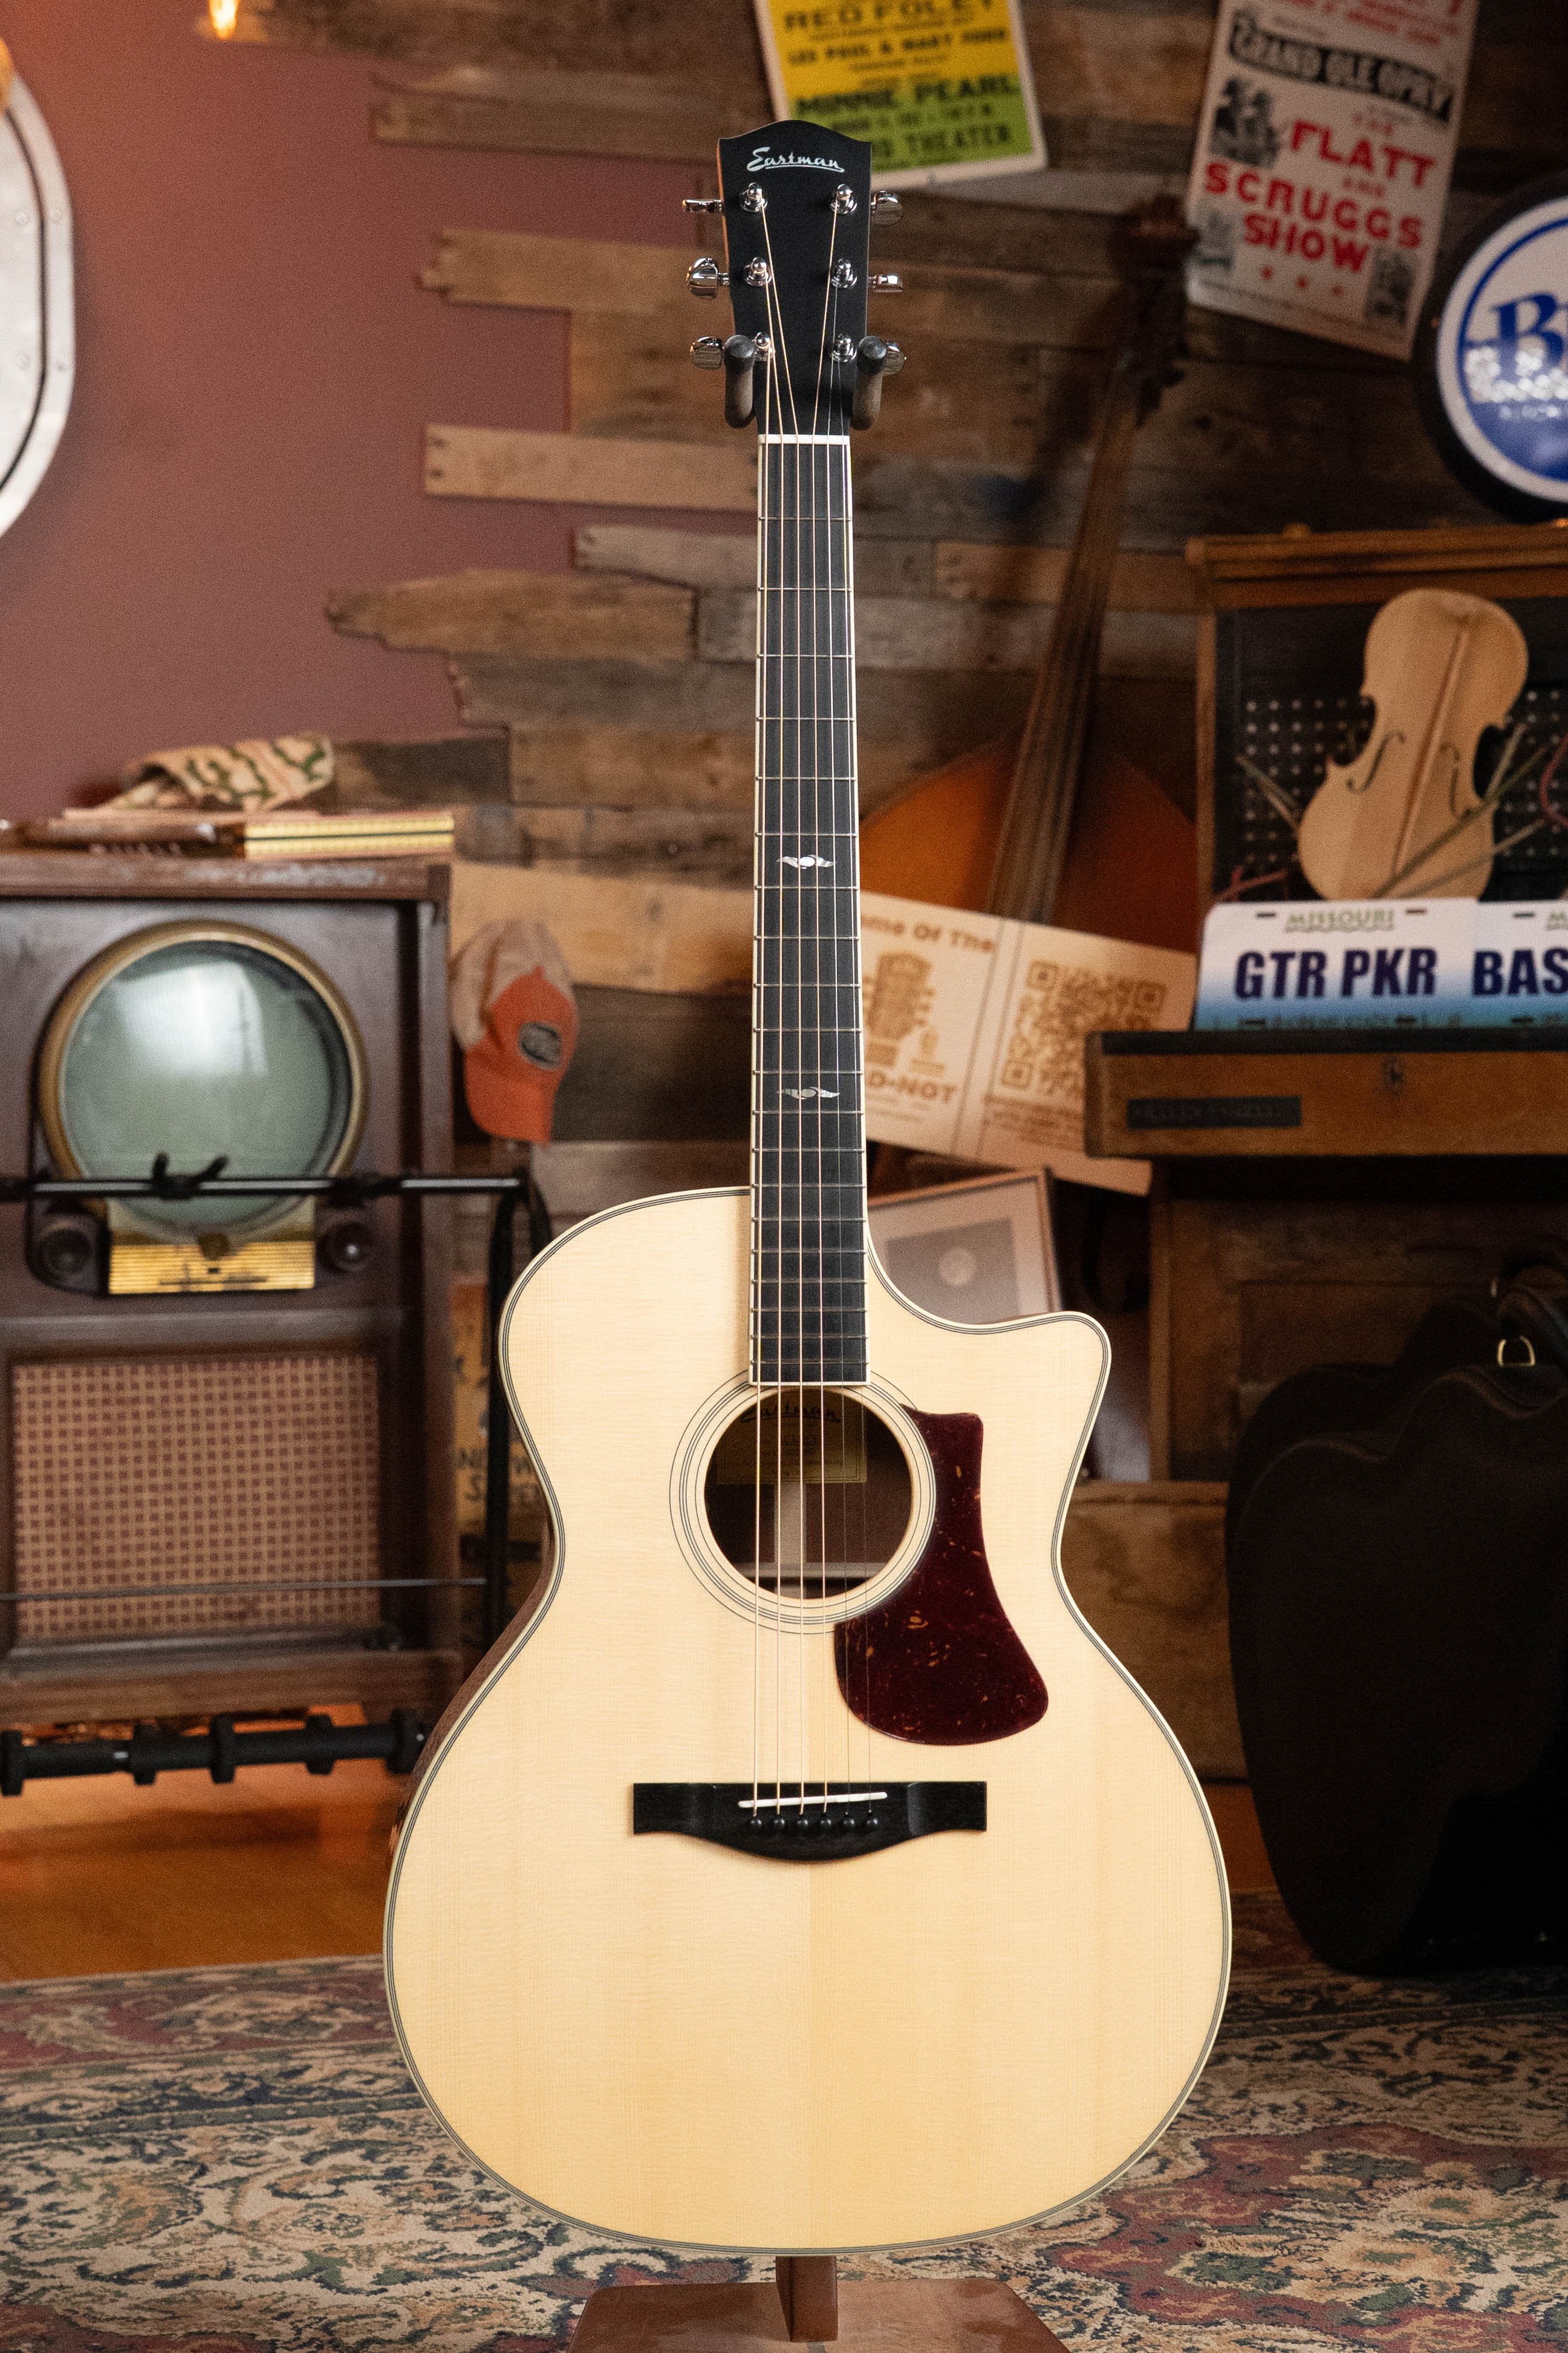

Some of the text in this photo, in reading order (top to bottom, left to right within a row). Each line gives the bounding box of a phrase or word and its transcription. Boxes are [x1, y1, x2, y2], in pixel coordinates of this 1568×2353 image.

[747, 146, 844, 172] Eastman
[1290, 119, 1436, 187] FLATT
[1205, 162, 1422, 249] SCRUGGS
[1243, 211, 1370, 273] SHOW
[1234, 948, 1437, 999] GTR PKR
